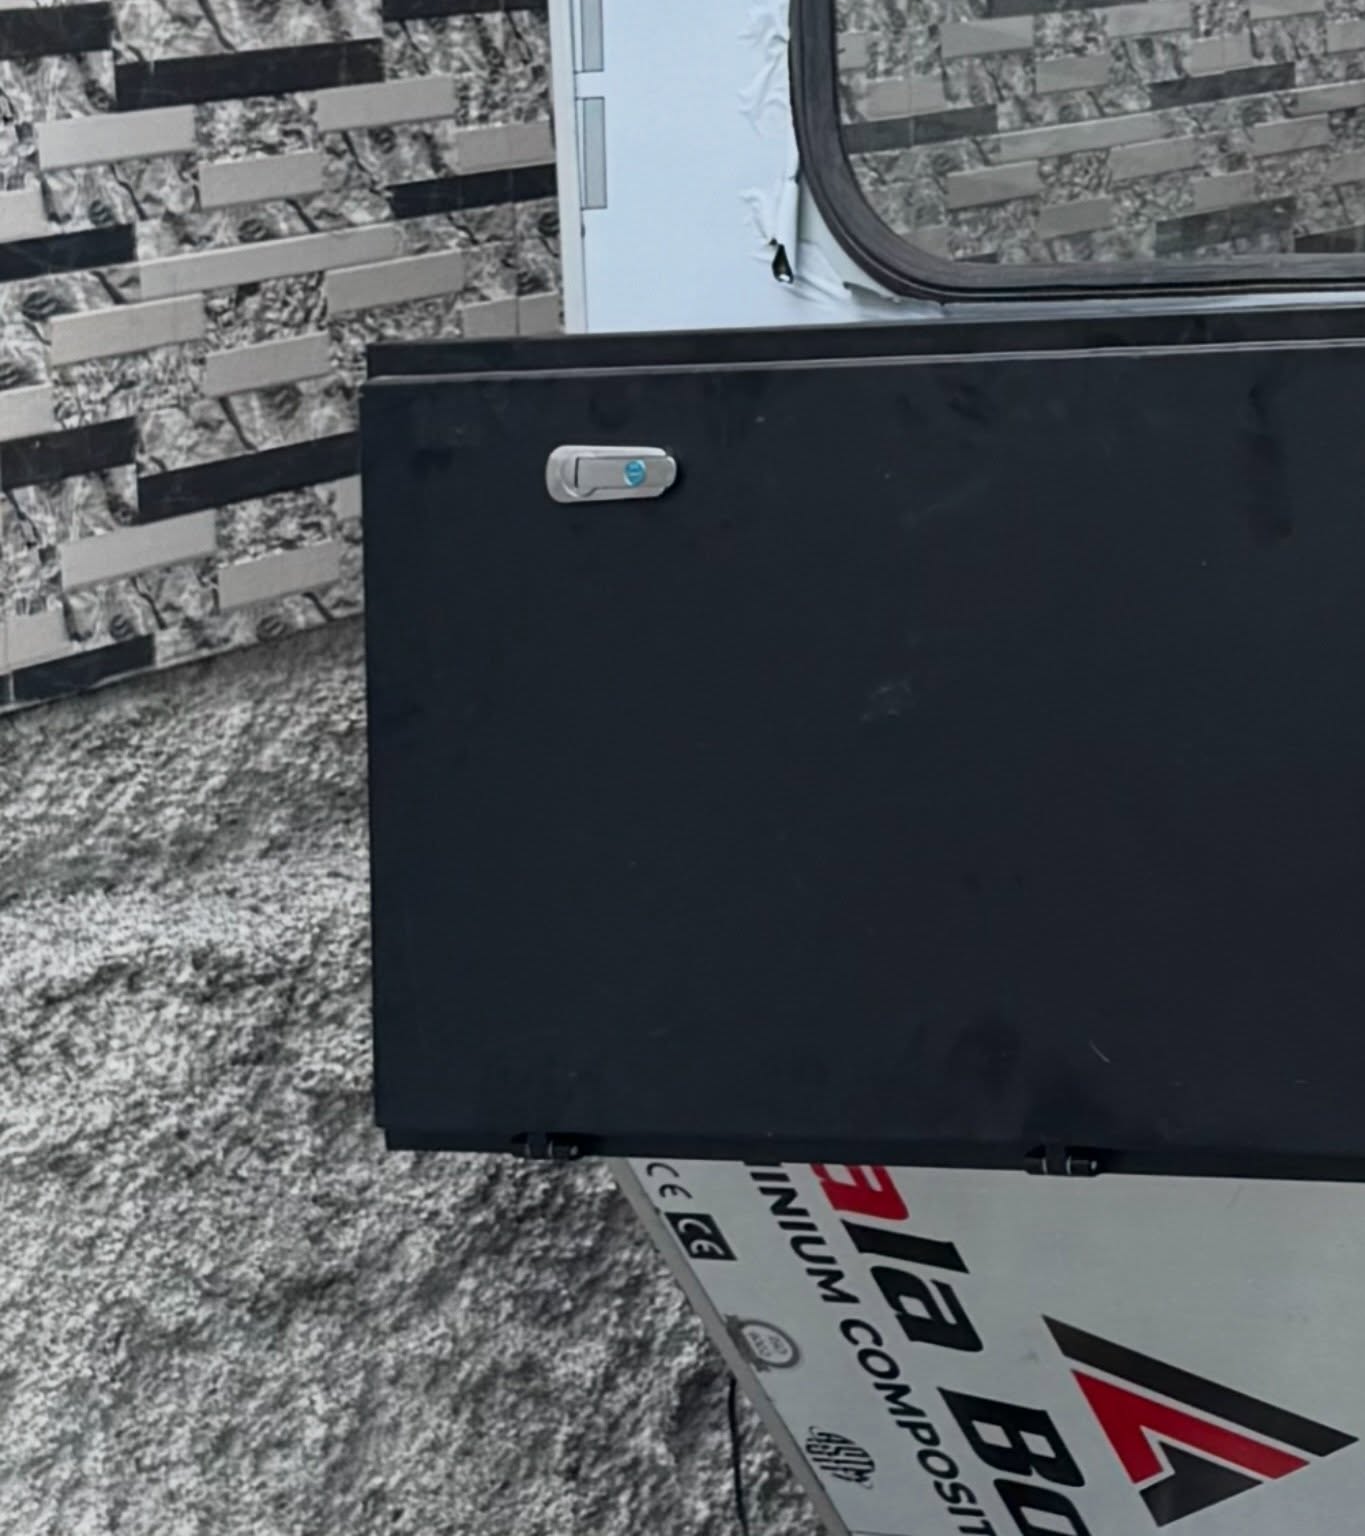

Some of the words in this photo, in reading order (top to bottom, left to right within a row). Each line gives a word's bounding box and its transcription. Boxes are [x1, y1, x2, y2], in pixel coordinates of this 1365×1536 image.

[678, 1218, 724, 1257] CE
[750, 1170, 860, 1304] INIUM
[839, 1319, 998, 1536] COMPOSIT
